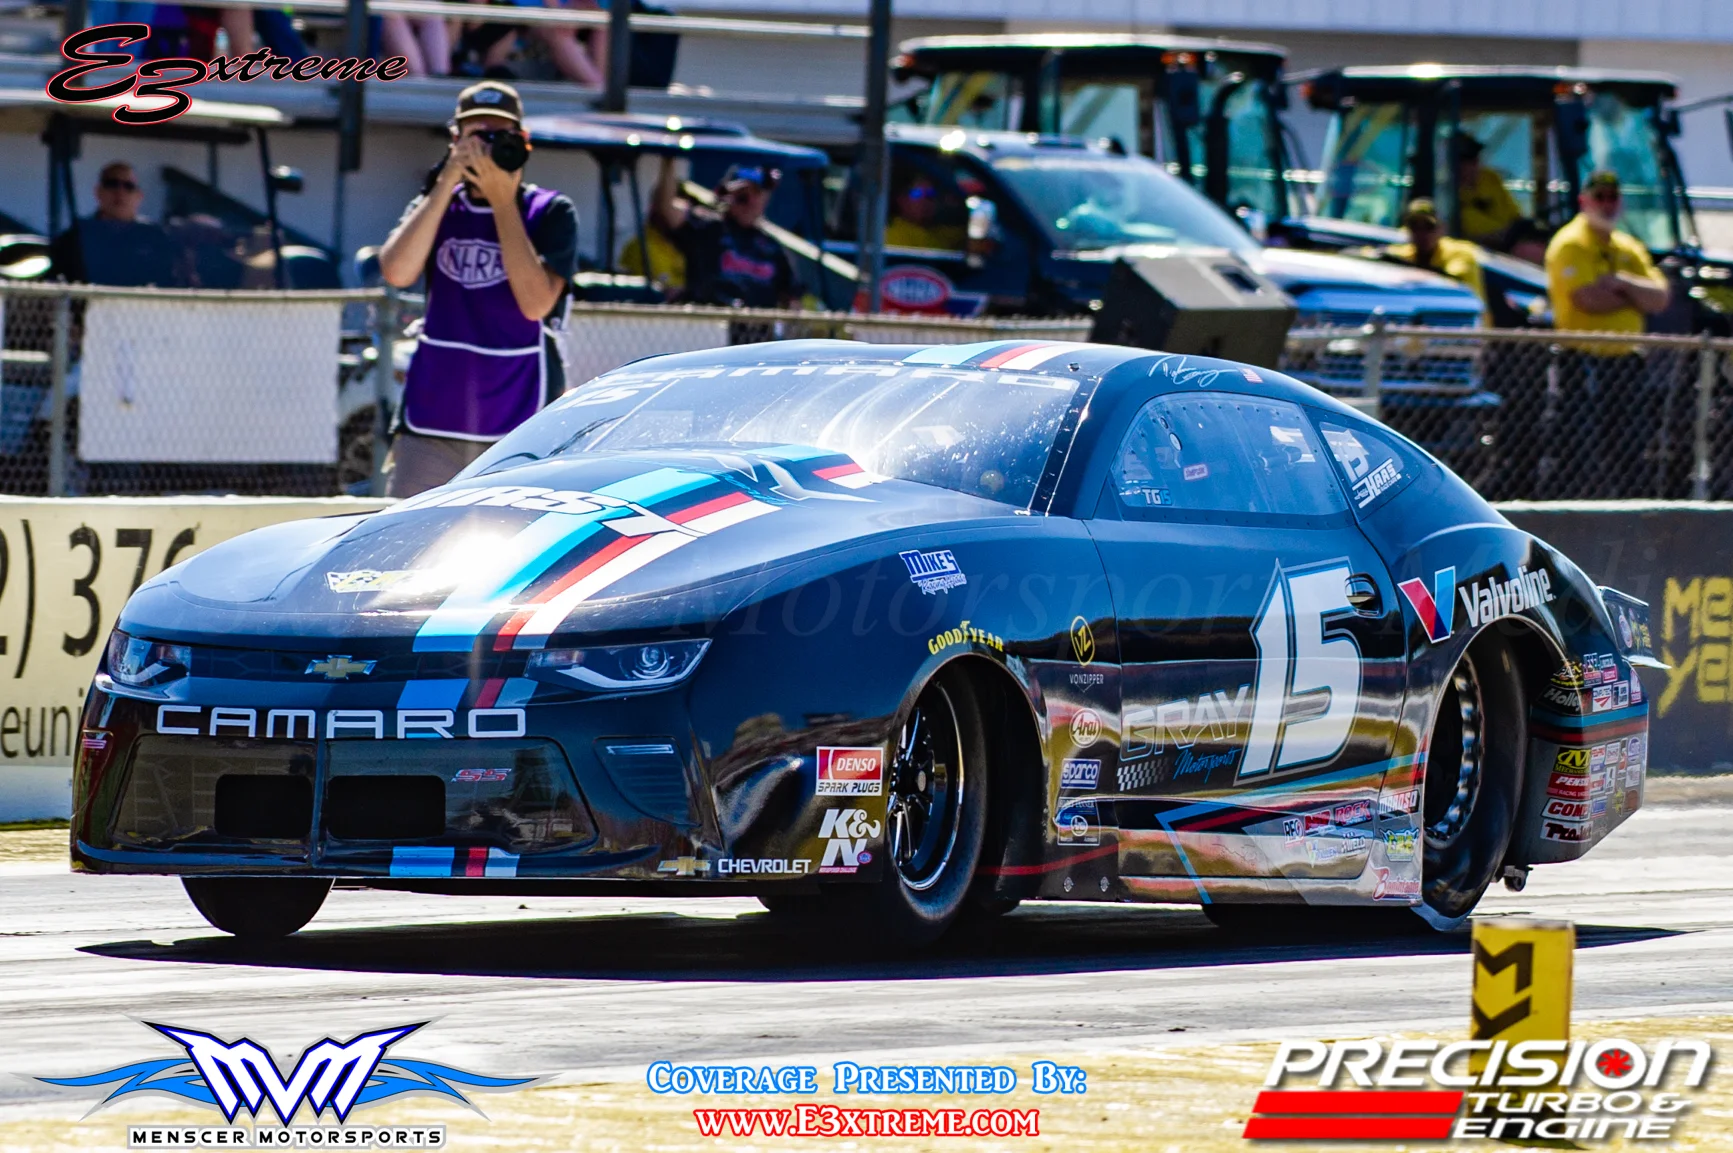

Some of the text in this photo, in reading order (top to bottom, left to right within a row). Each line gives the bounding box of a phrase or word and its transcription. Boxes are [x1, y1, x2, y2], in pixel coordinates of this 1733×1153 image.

[1233, 558, 1363, 786] 15
[156, 704, 527, 740] CAMARO
[835, 757, 877, 773] DENSO
[817, 782, 881, 793] SPARK PLUGS
[717, 859, 812, 873] CHEVROLET
